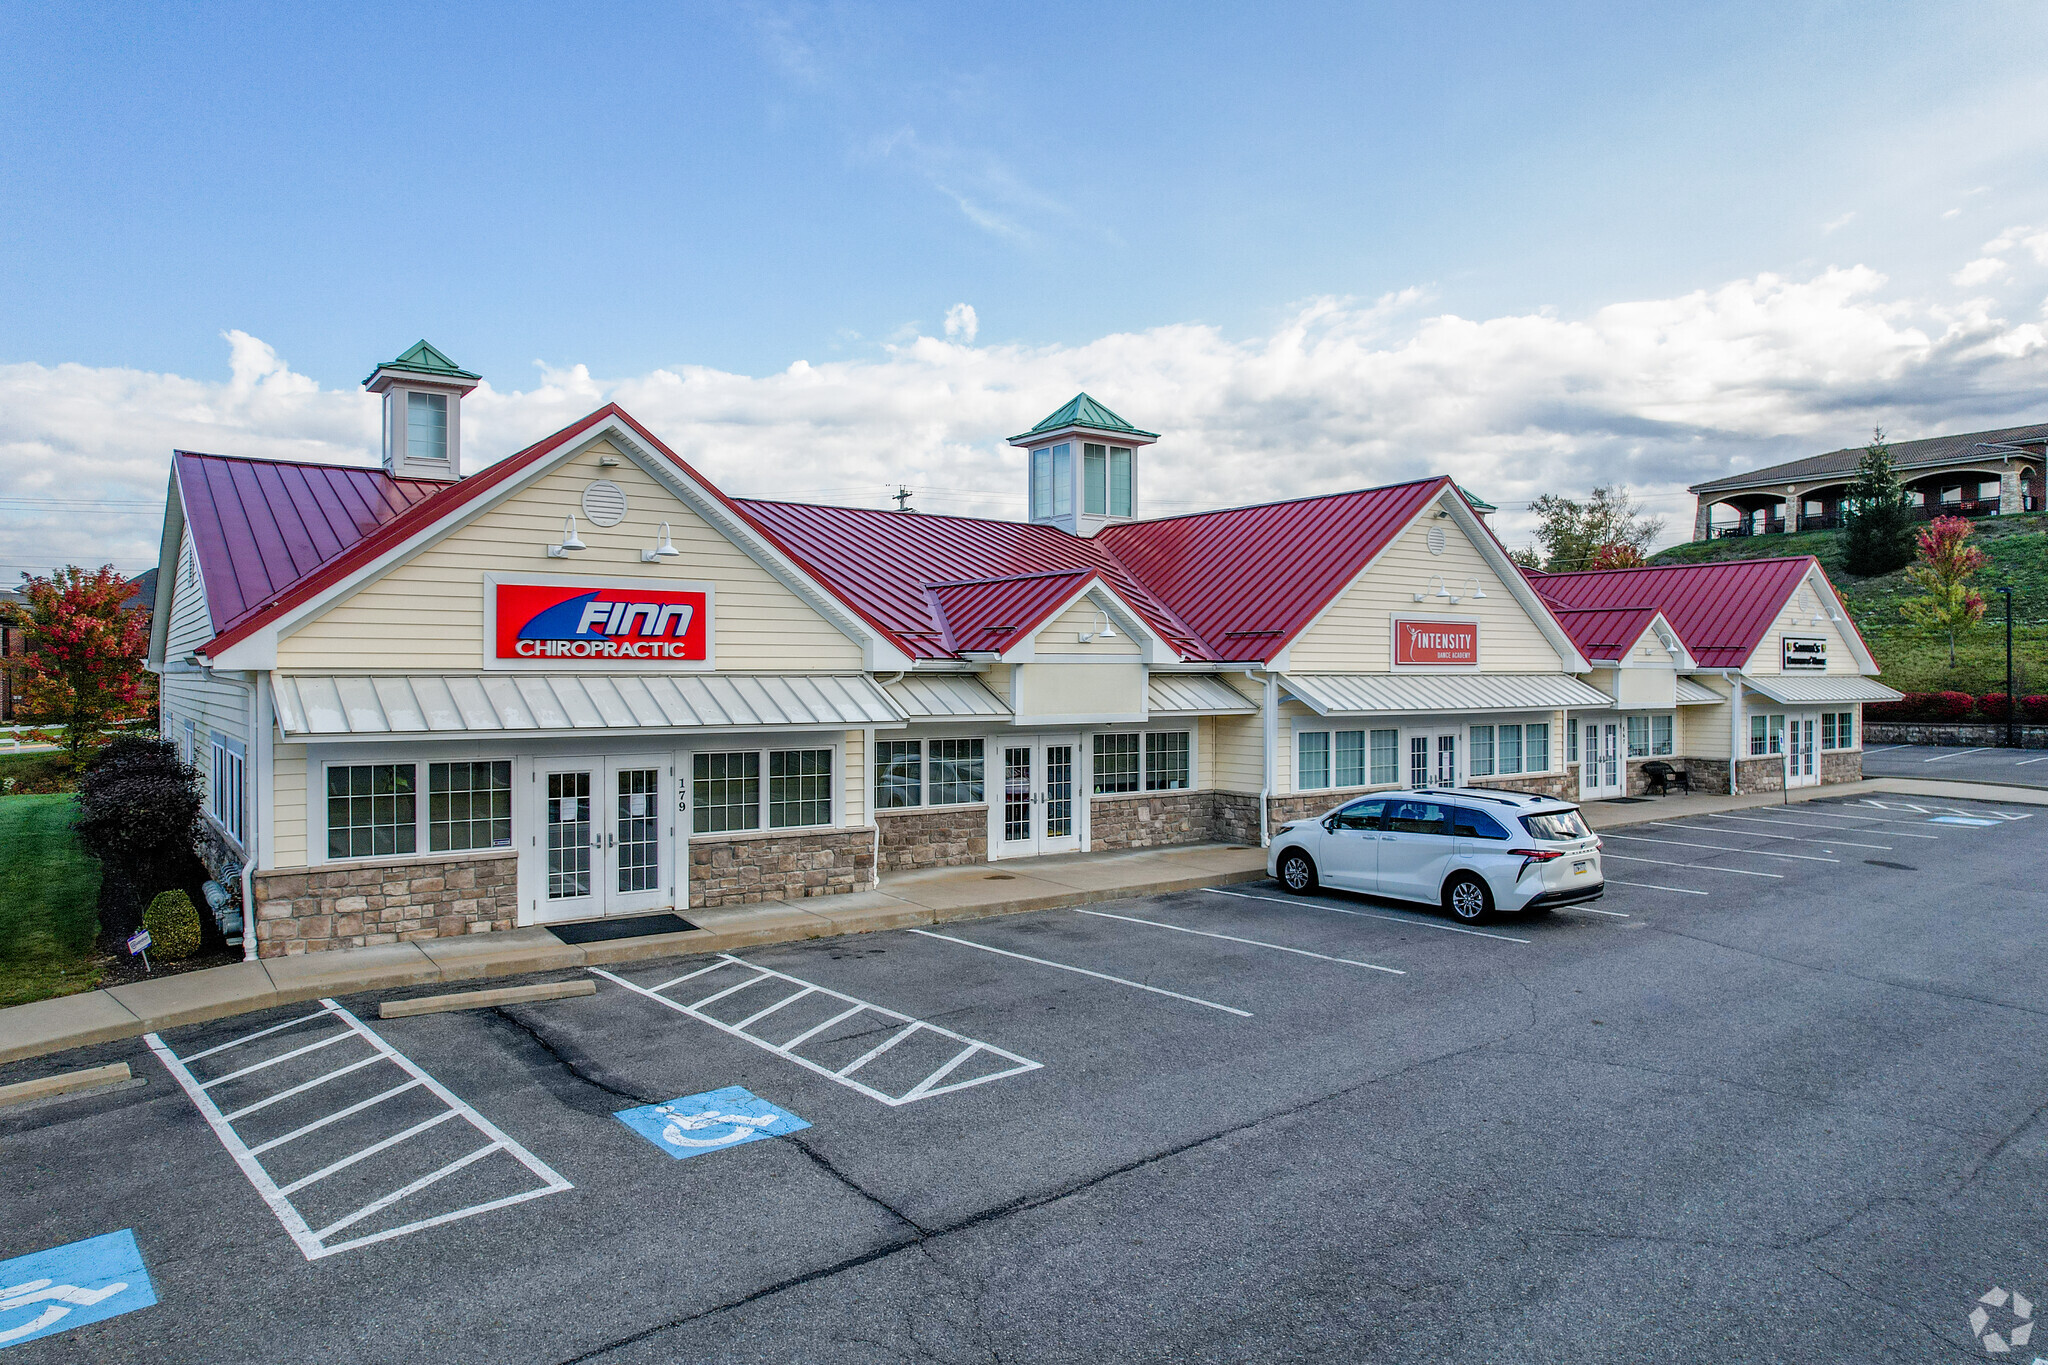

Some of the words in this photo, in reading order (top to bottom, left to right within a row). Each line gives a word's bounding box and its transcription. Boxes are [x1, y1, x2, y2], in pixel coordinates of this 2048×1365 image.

[515, 639, 686, 658] CHIROPRACTIC
[1417, 632, 1472, 650] INTENSITY
[1437, 651, 1451, 659] DANCE
[678, 778, 687, 812] 179
